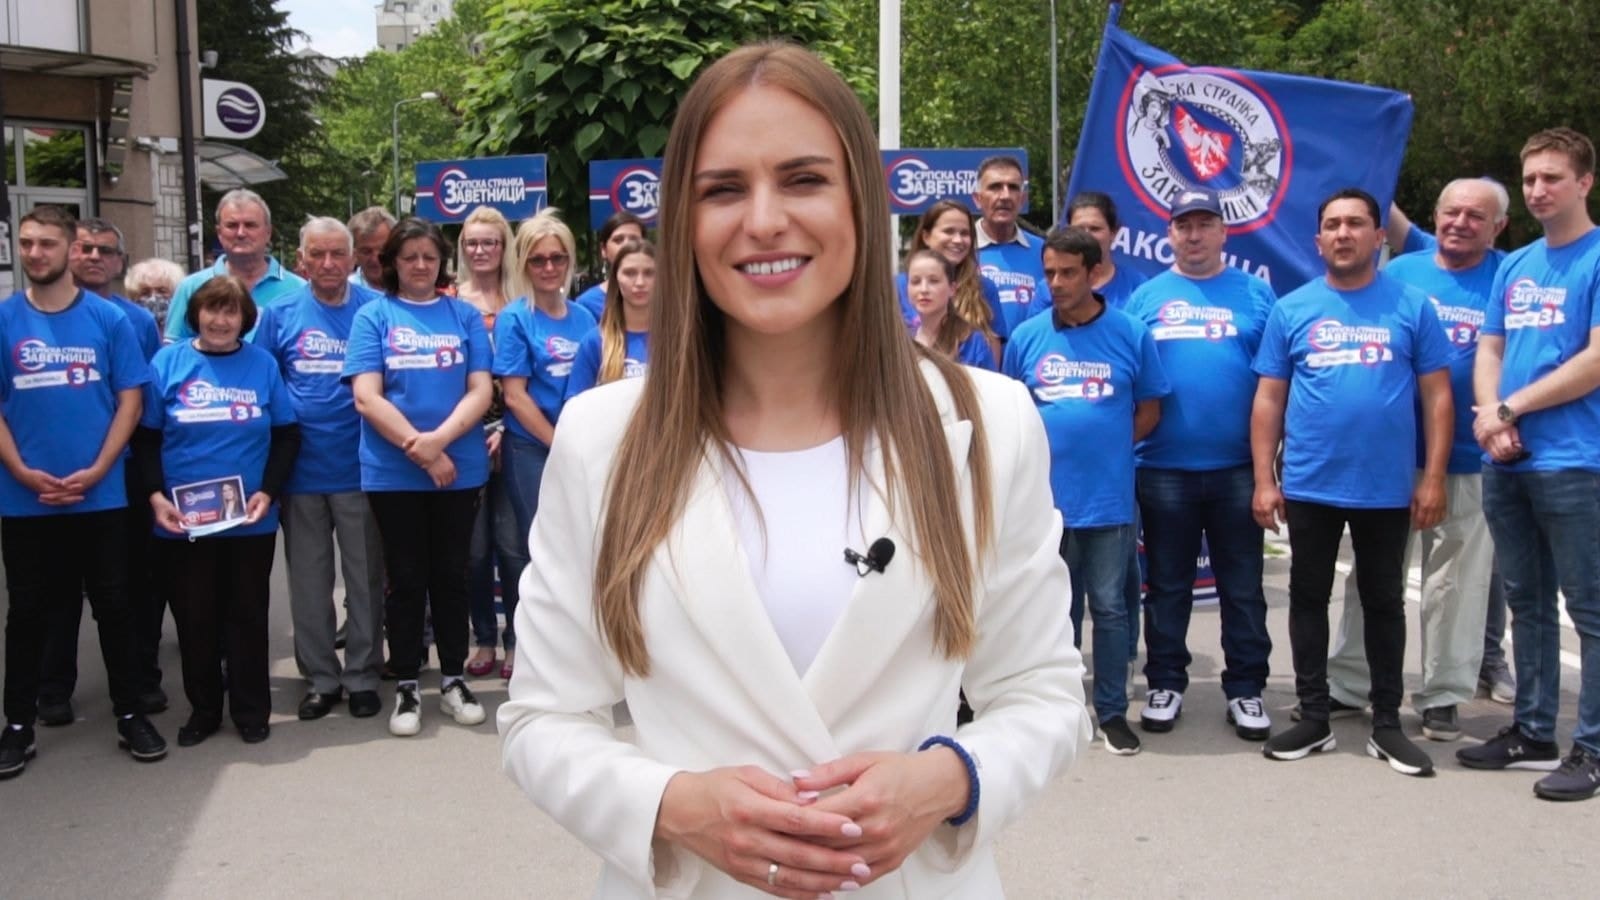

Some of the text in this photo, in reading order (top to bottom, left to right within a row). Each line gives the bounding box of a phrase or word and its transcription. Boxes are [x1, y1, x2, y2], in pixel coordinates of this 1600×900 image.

[1203, 83, 1259, 126] СТРАНКА
[897, 169, 979, 195] ЗАВЕТНИ
[914, 170, 955, 180] СРПСКА
[444, 178, 525, 204] ЗАВЕТНИЦИ
[455, 177, 525, 190] СРПСКА СТРАНКА
[1210, 324, 1223, 338] 3
[1458, 328, 1471, 344] 3
[439, 351, 454, 367] 3
[1365, 348, 1379, 364] 3
[71, 367, 86, 385] 3
[1087, 381, 1099, 398] 3
[235, 405, 249, 420] 3
